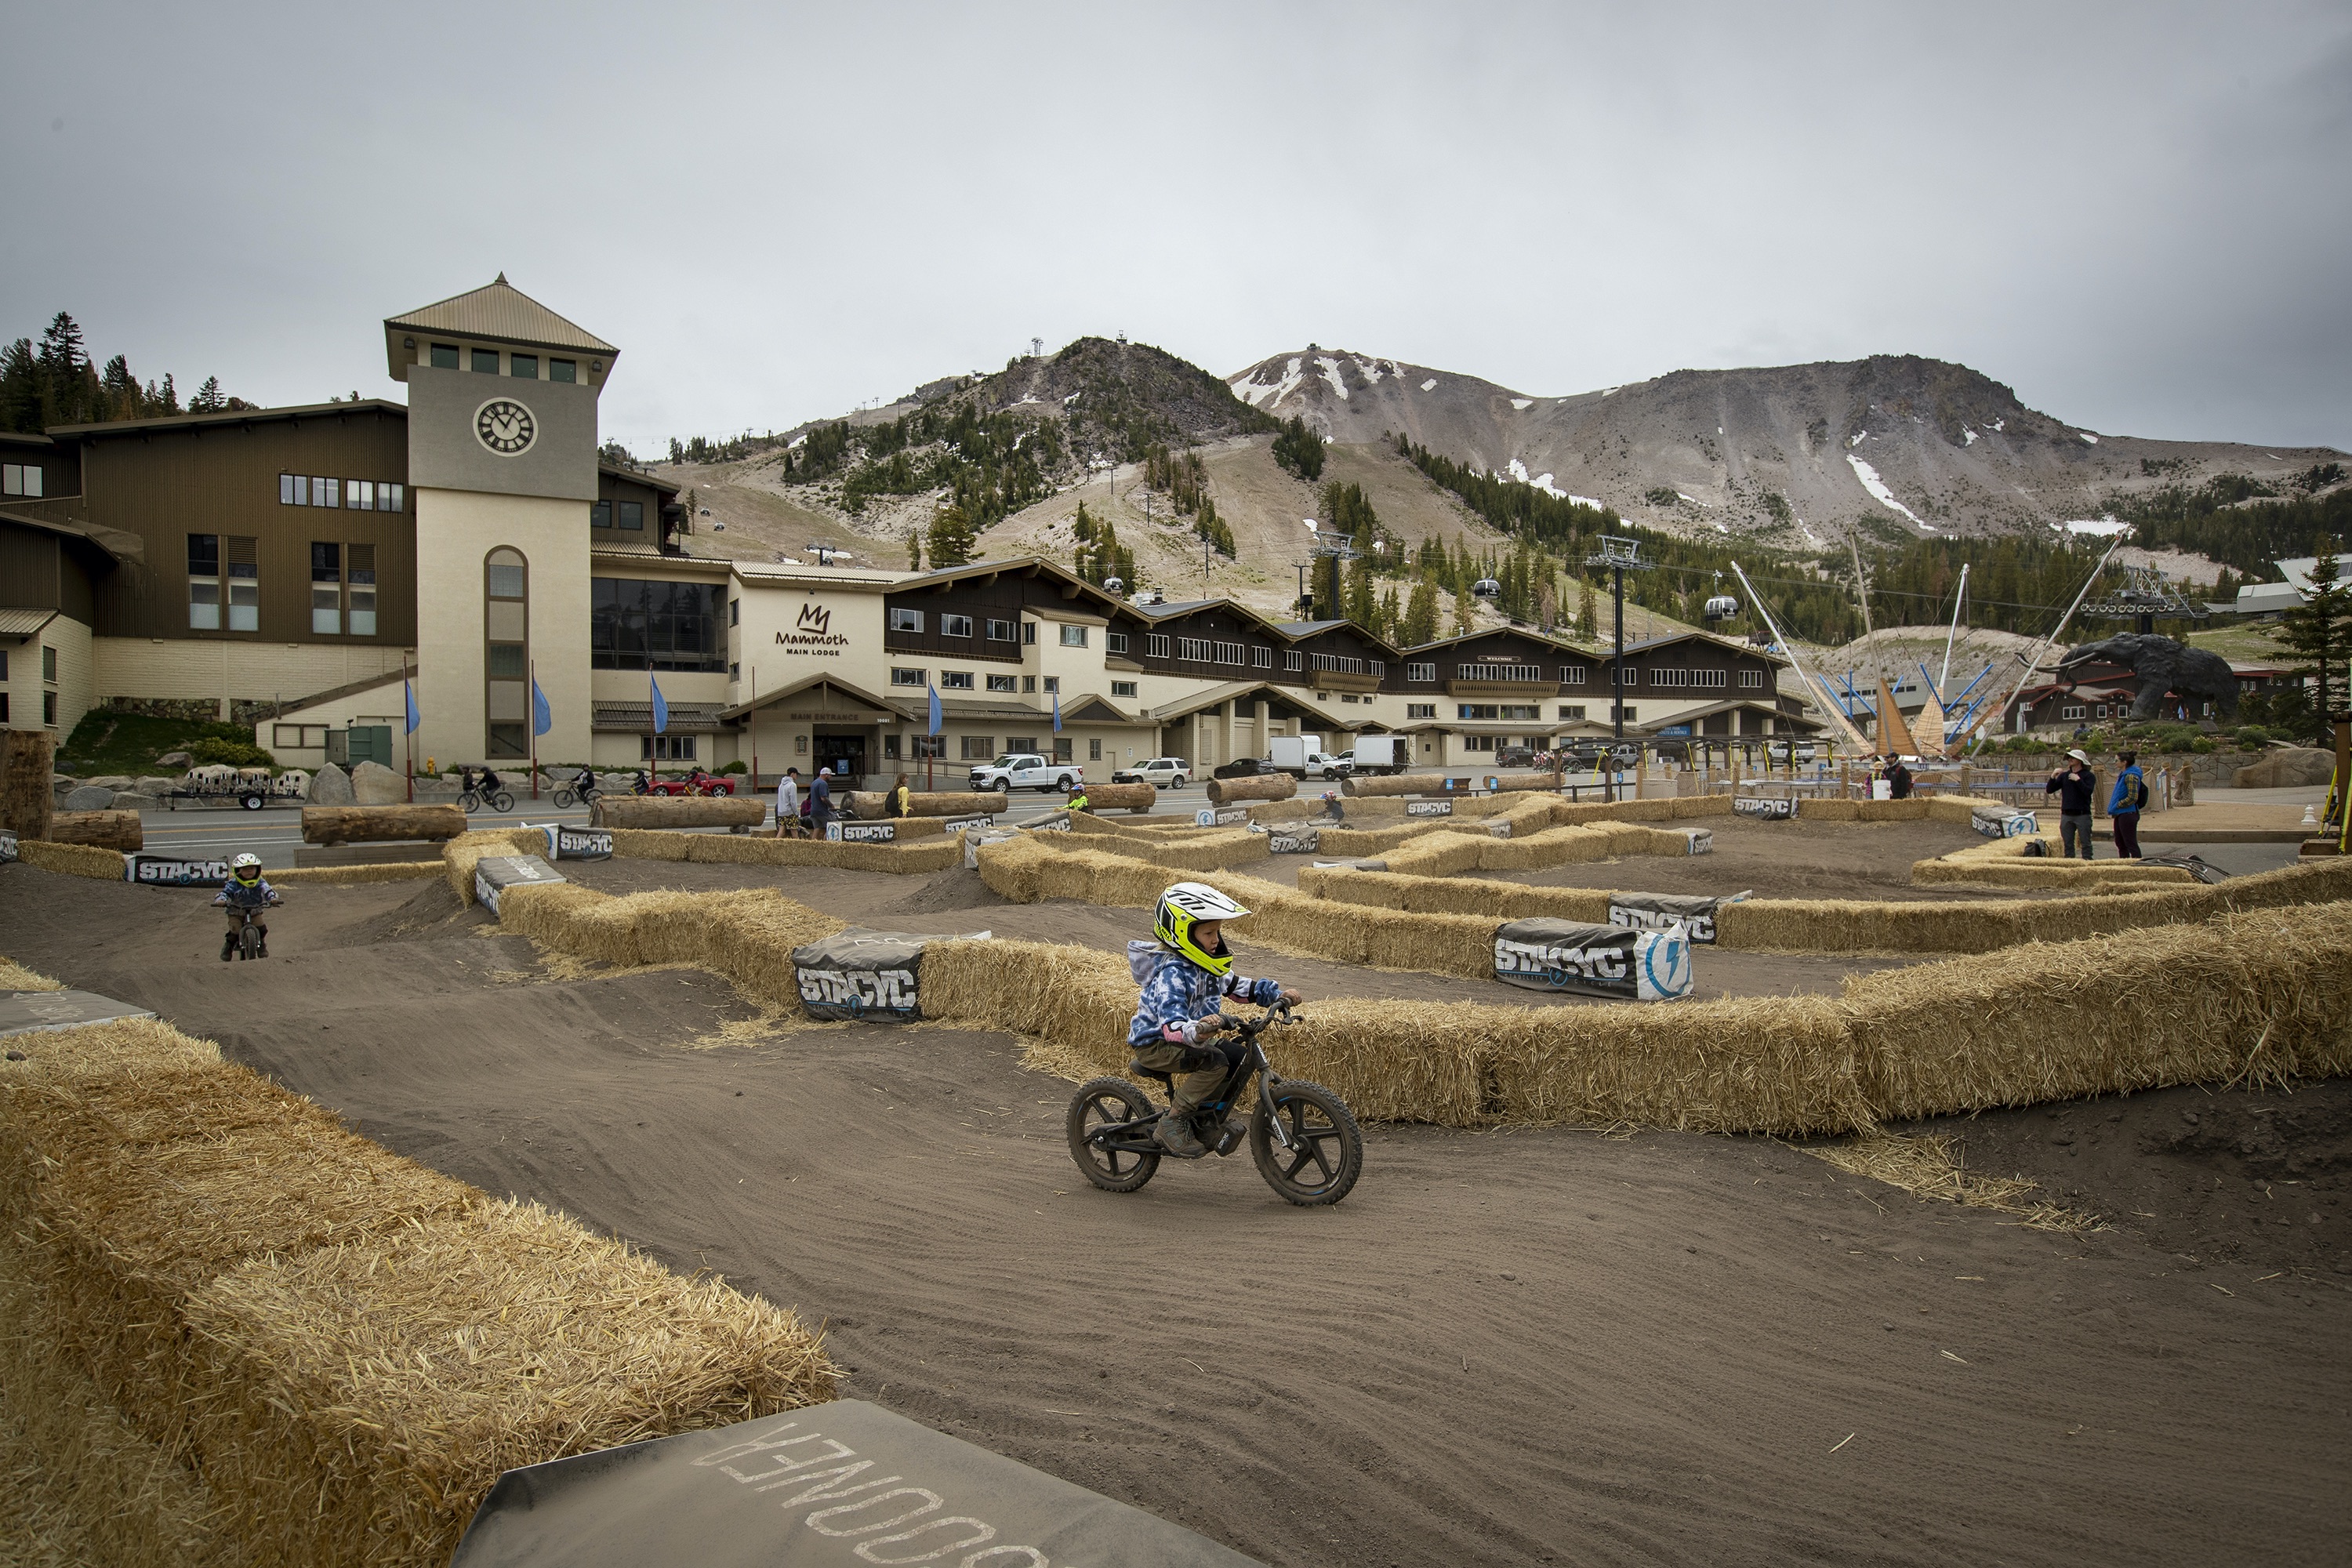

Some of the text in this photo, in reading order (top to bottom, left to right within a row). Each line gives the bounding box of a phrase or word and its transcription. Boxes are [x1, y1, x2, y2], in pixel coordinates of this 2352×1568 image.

[775, 631, 849, 645] Mammoth
[1408, 802, 1451, 814] STACYC
[1734, 798, 1789, 813] STACYC
[1217, 810, 1247, 825] STACYC
[844, 826, 894, 839] STACYC
[560, 832, 613, 852] STACYC
[140, 862, 228, 880] STACYC
[1161, 927, 1171, 939] BELL
[1494, 938, 1627, 978] STACYC
[798, 967, 917, 1008] STACYC
[1573, 978, 1612, 987] CYCLE
